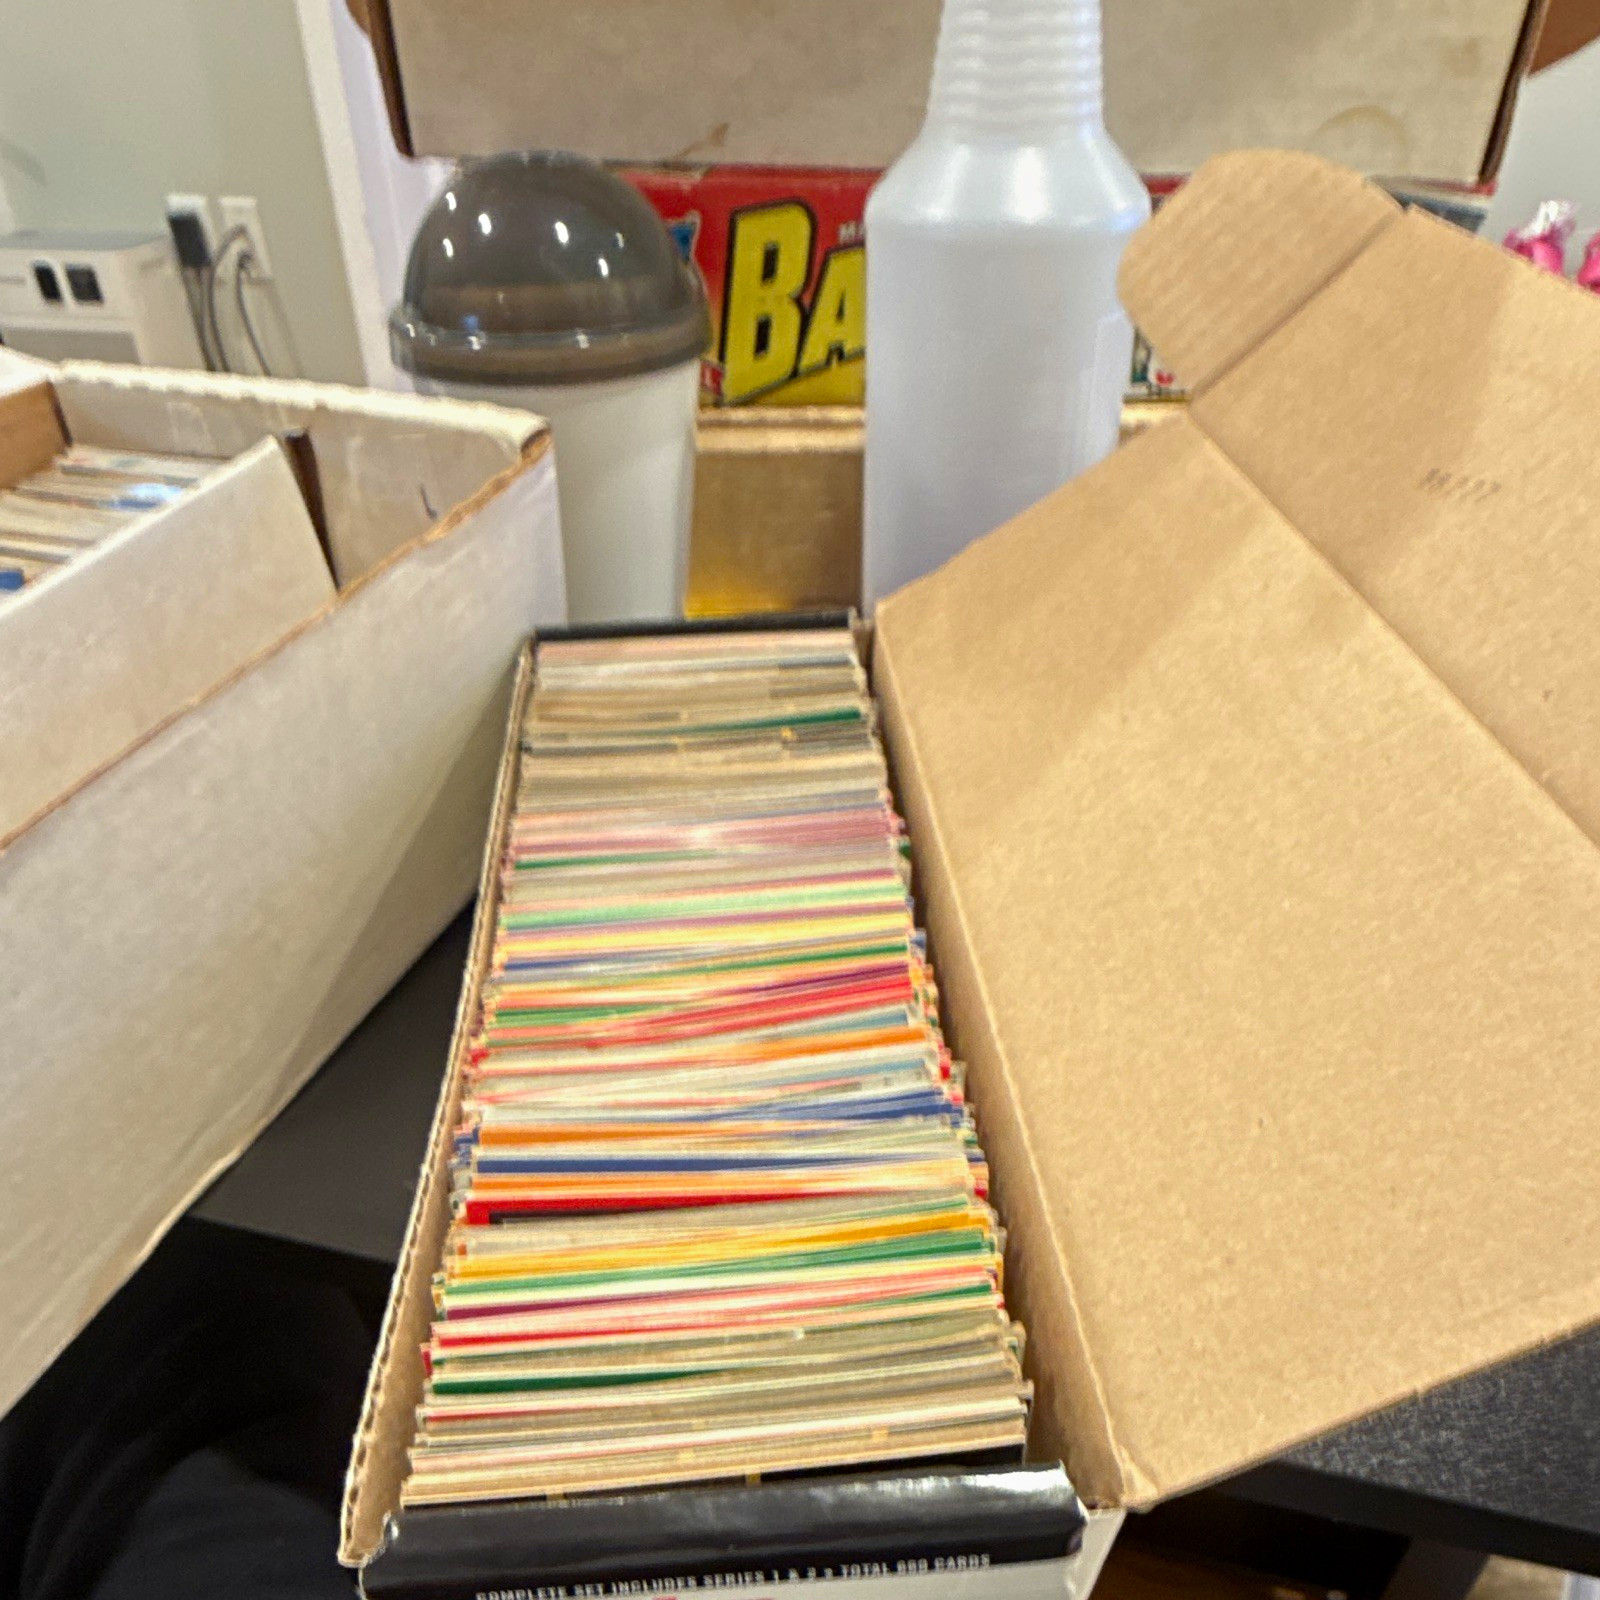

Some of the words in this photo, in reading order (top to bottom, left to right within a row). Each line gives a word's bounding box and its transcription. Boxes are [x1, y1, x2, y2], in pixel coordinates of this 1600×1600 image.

[475, 1585, 568, 1600] COMPLETE
[573, 1583, 604, 1597] SET
[611, 1575, 697, 1595] INCLUDES
[704, 1570, 765, 1587] SERIES
[841, 1562, 889, 1579] TOTAL
[934, 1553, 990, 1571] CARDS
